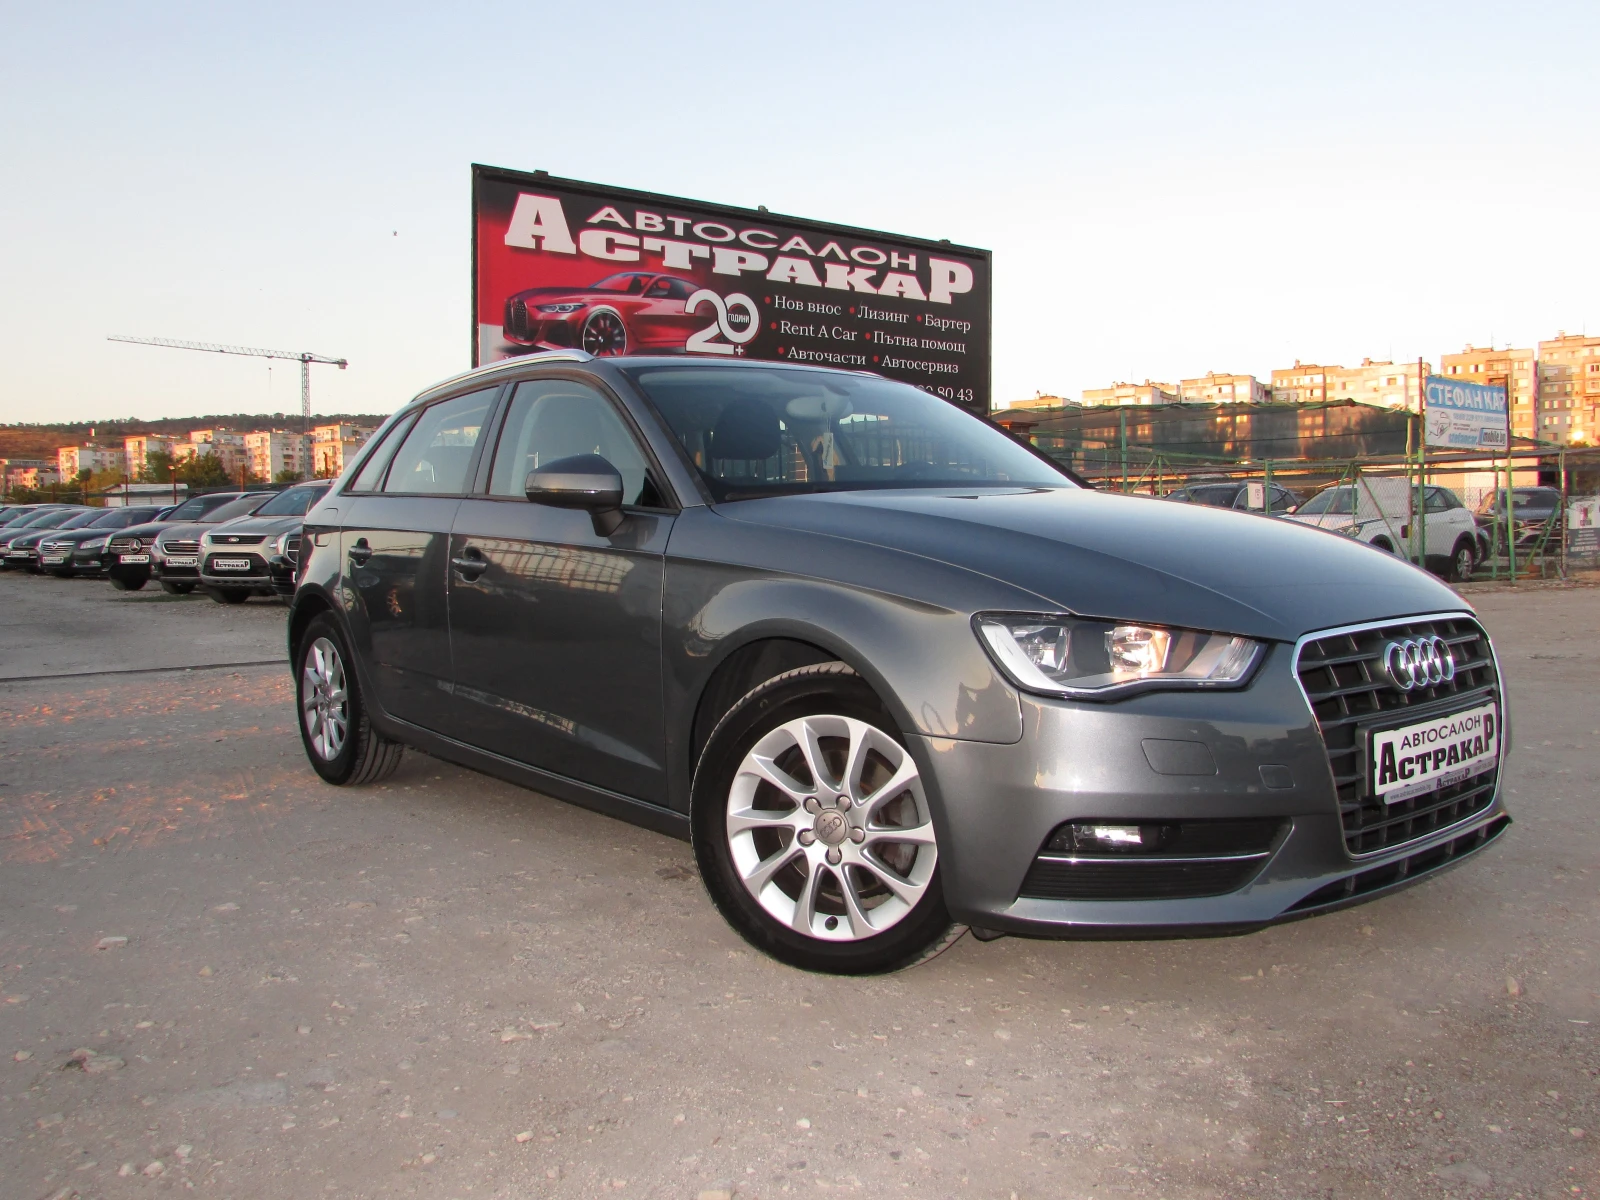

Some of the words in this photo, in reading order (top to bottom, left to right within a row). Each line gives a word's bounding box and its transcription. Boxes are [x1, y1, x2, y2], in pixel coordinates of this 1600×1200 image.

[586, 206, 917, 271] АВТОСАЛОН
[774, 295, 804, 312] Нов
[808, 302, 842, 316] внос
[857, 305, 910, 324] Лизинг
[924, 314, 971, 334] Бартер
[780, 321, 815, 338] Rent
[818, 325, 830, 338] A
[831, 327, 858, 342] Car
[873, 331, 918, 348] Пътна
[921, 338, 966, 354] помощ
[787, 347, 867, 366] Авточасти
[882, 355, 959, 374] Автосервиз
[957, 388, 973, 402] 43
[1426, 382, 1483, 409] СТЕФАН
[1483, 391, 1506, 412] КАР
[1400, 714, 1481, 751] АВТОСАЛОН
